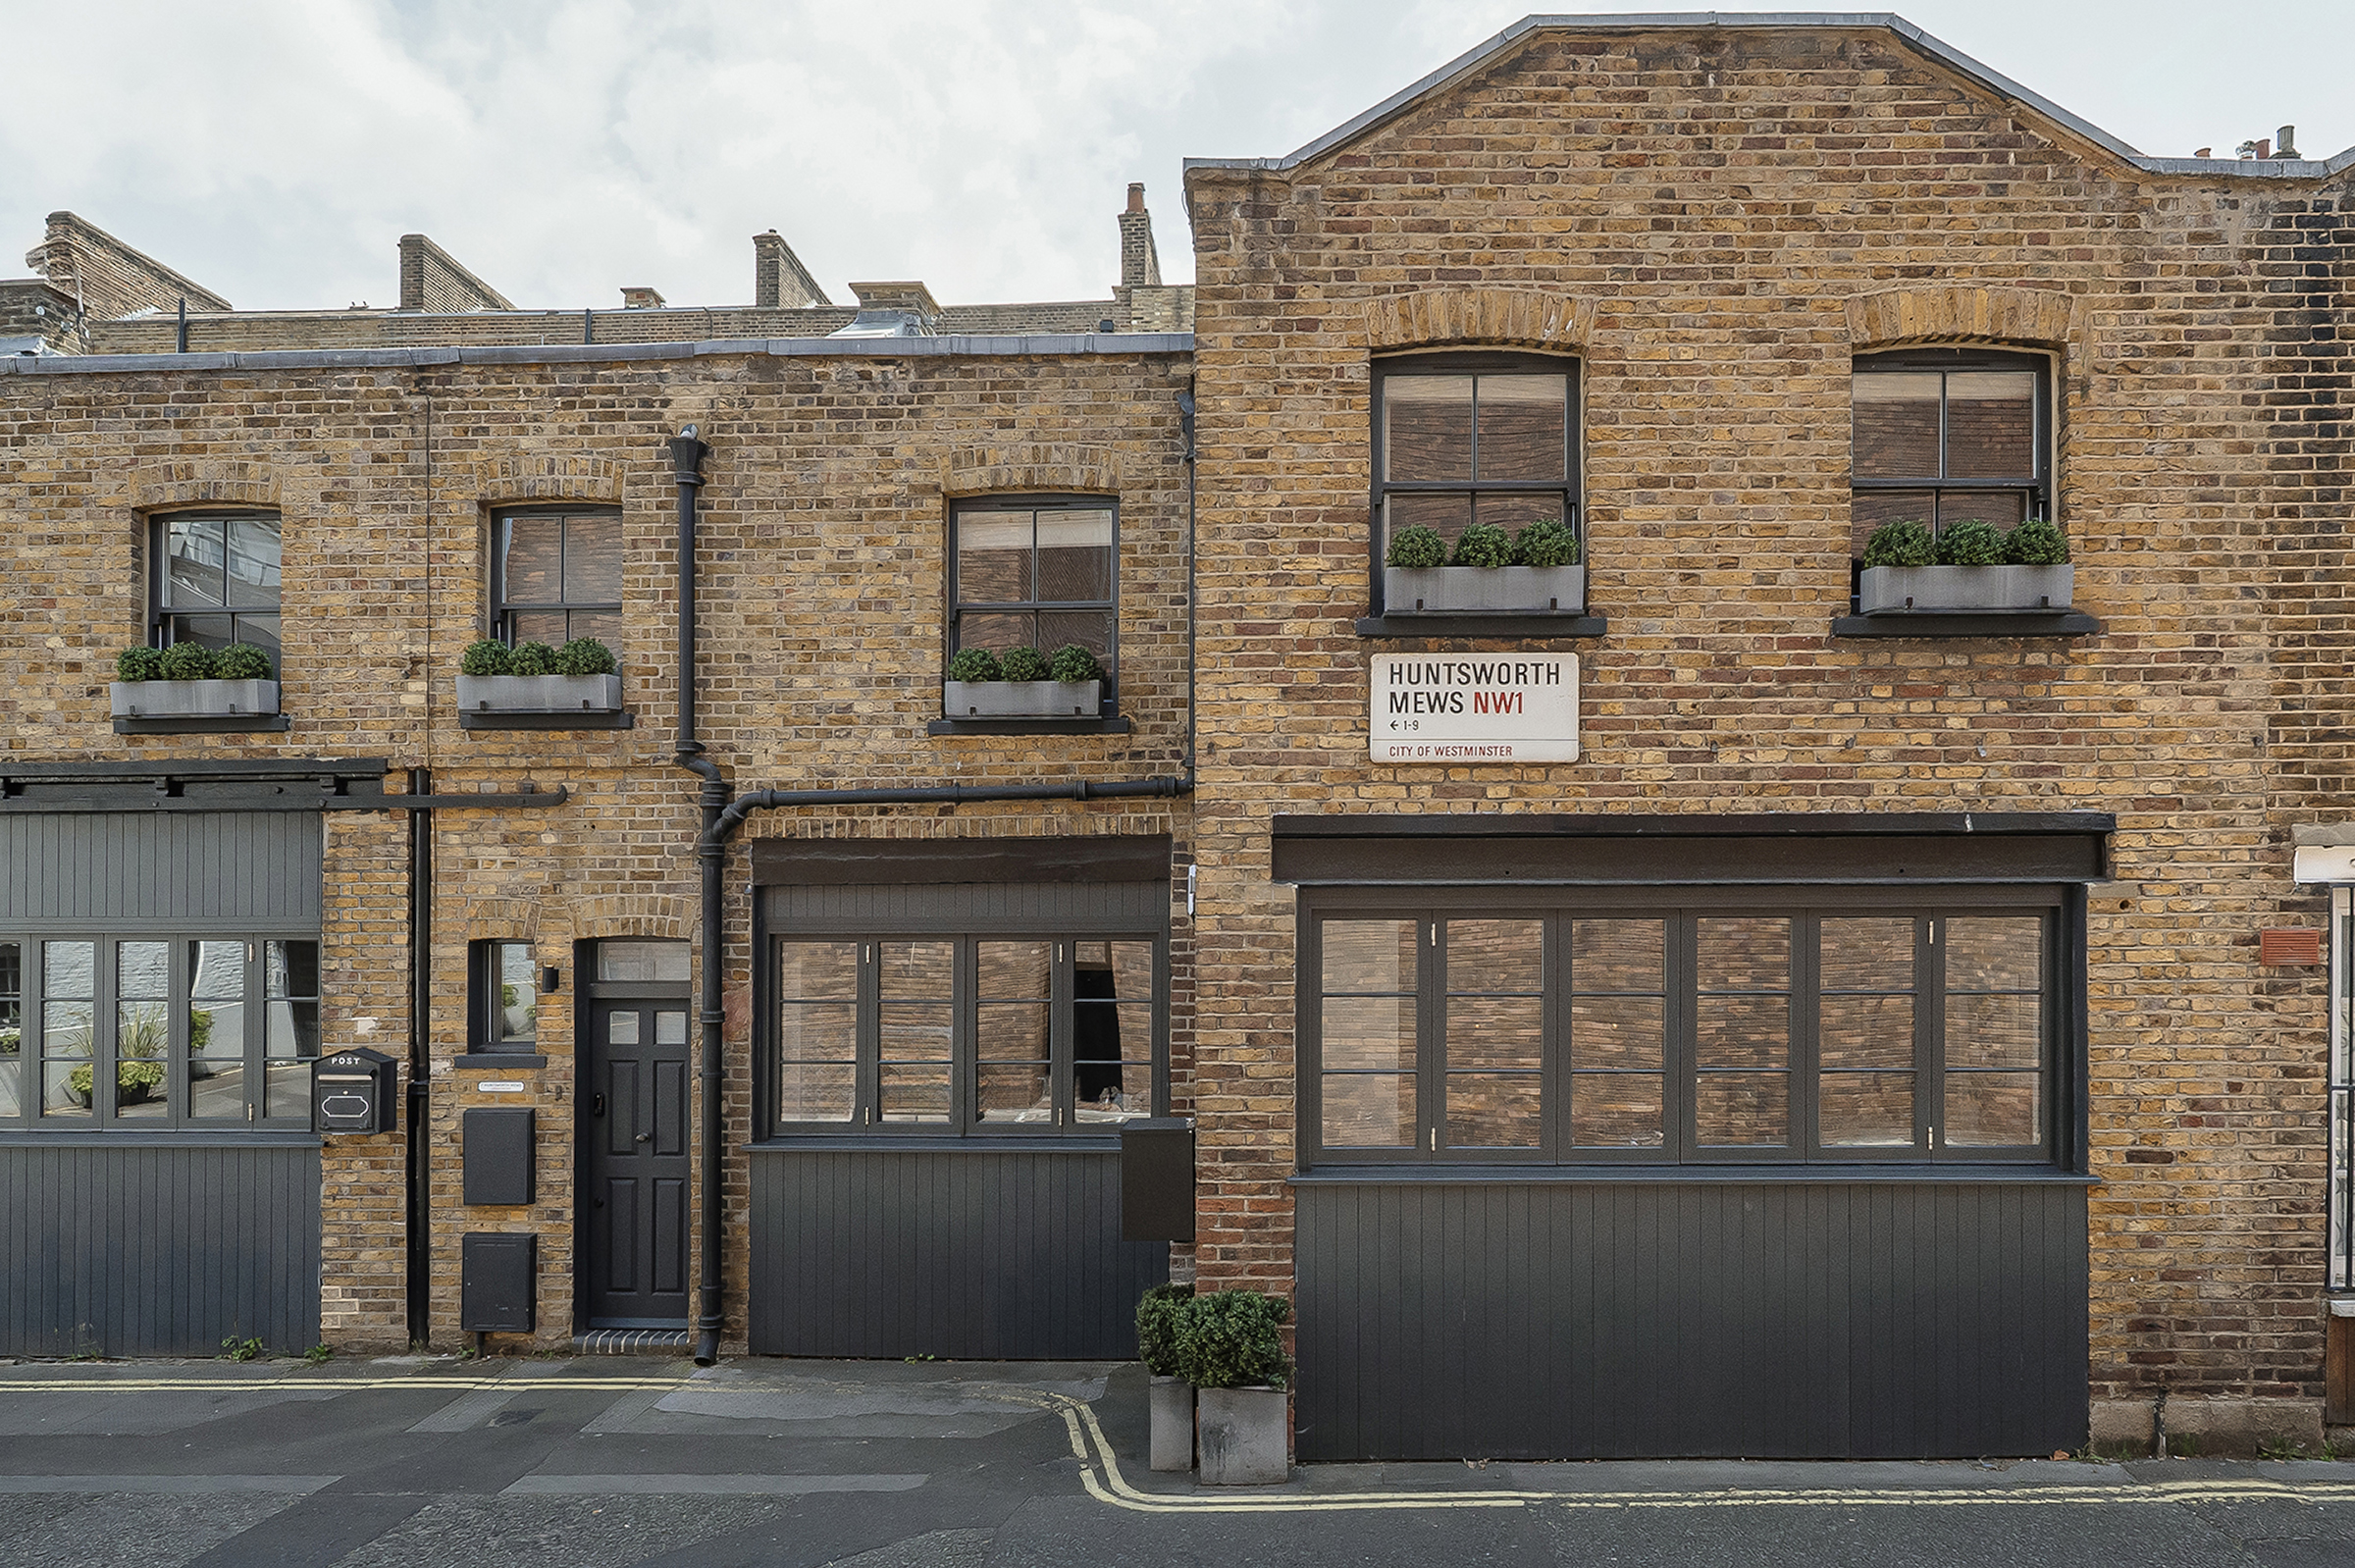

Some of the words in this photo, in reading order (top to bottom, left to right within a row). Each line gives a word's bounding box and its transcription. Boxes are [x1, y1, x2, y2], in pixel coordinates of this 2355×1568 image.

[1389, 662, 1560, 685] HUNTSWORTH
[1389, 692, 1464, 713] MEWS
[1473, 692, 1523, 713] NW1
[1403, 720, 1419, 731] 1-9
[1388, 746, 1413, 757] CITY
[1417, 746, 1431, 757] OF
[1435, 746, 1513, 757] WESTMINSTER
